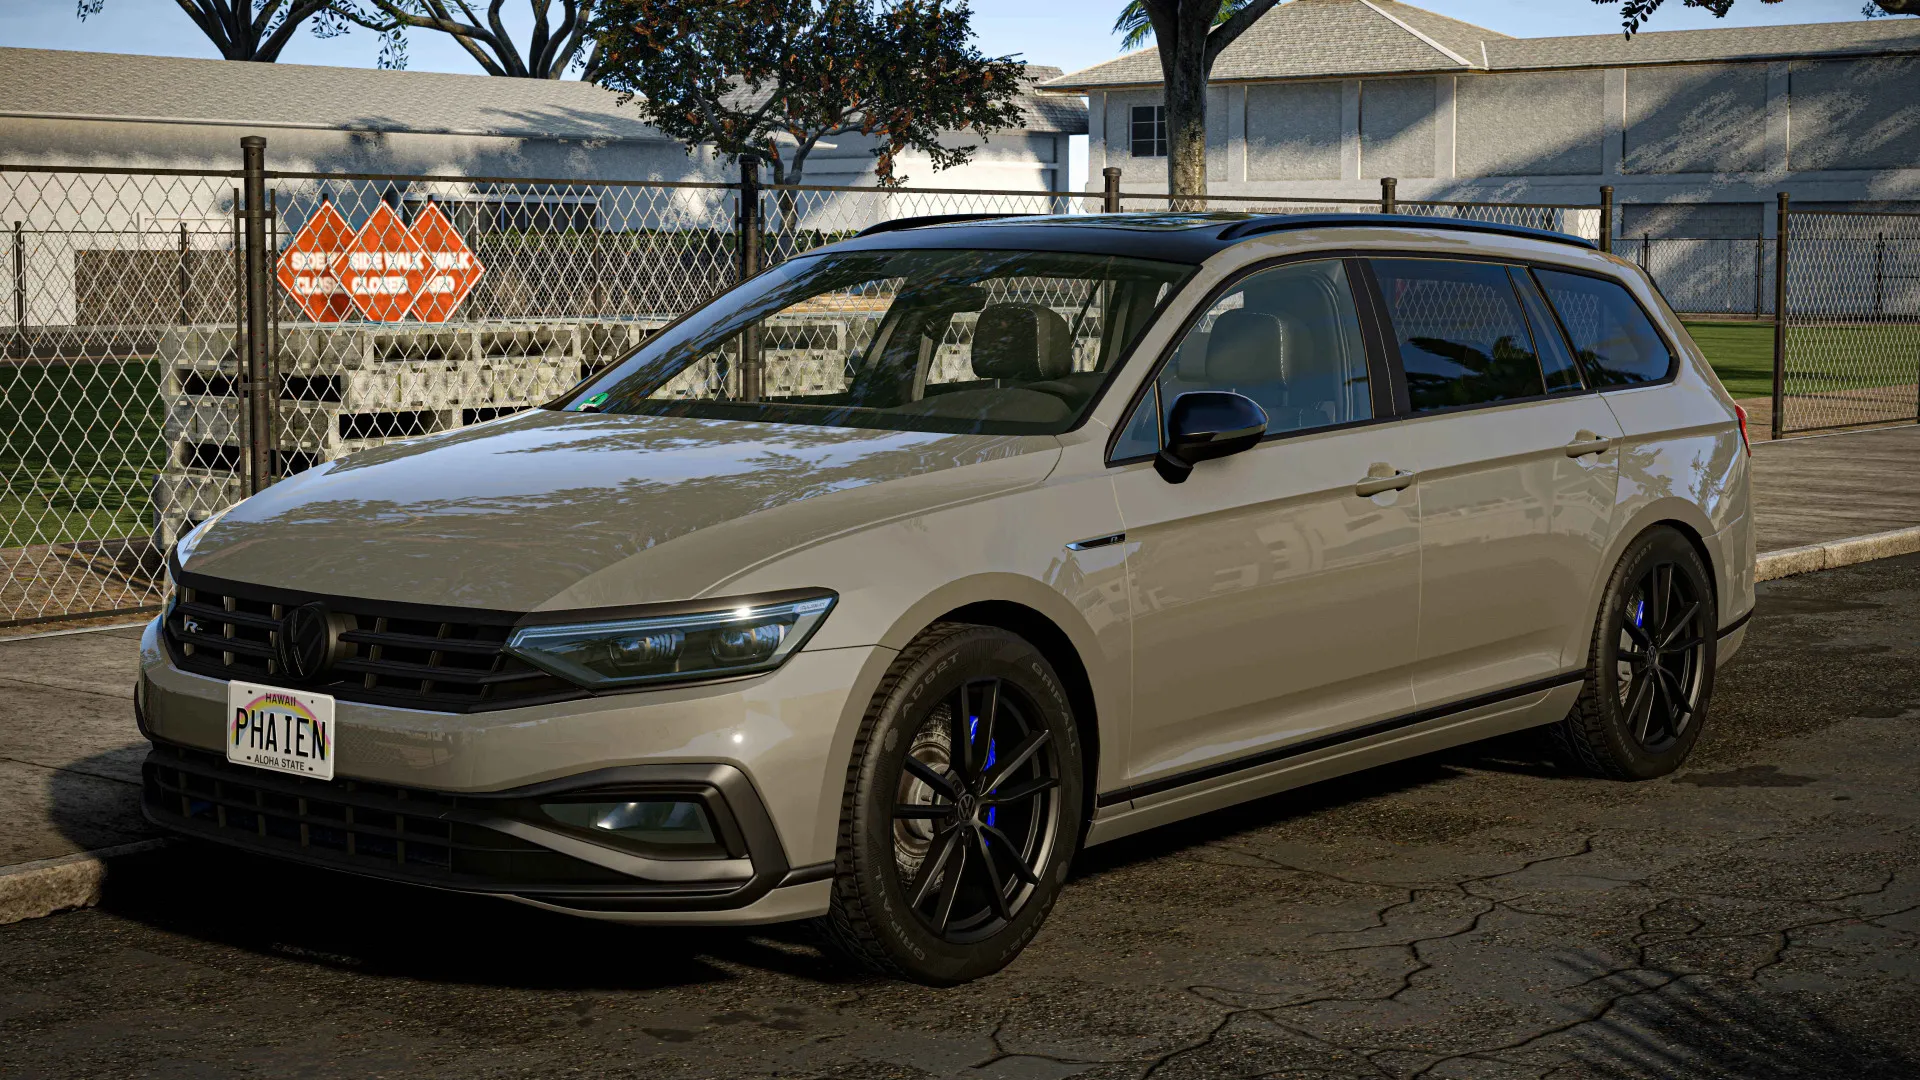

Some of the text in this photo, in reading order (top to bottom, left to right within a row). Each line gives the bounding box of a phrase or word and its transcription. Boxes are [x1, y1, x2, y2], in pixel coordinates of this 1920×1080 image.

[291, 251, 326, 271] SIDE
[349, 251, 383, 271] SIDE
[383, 251, 424, 271] WALK
[351, 276, 408, 295] CLOSED
[265, 692, 297, 707] HAWAII
[235, 707, 326, 761] PHAIEN
[254, 754, 305, 771] ALOHA STATE
